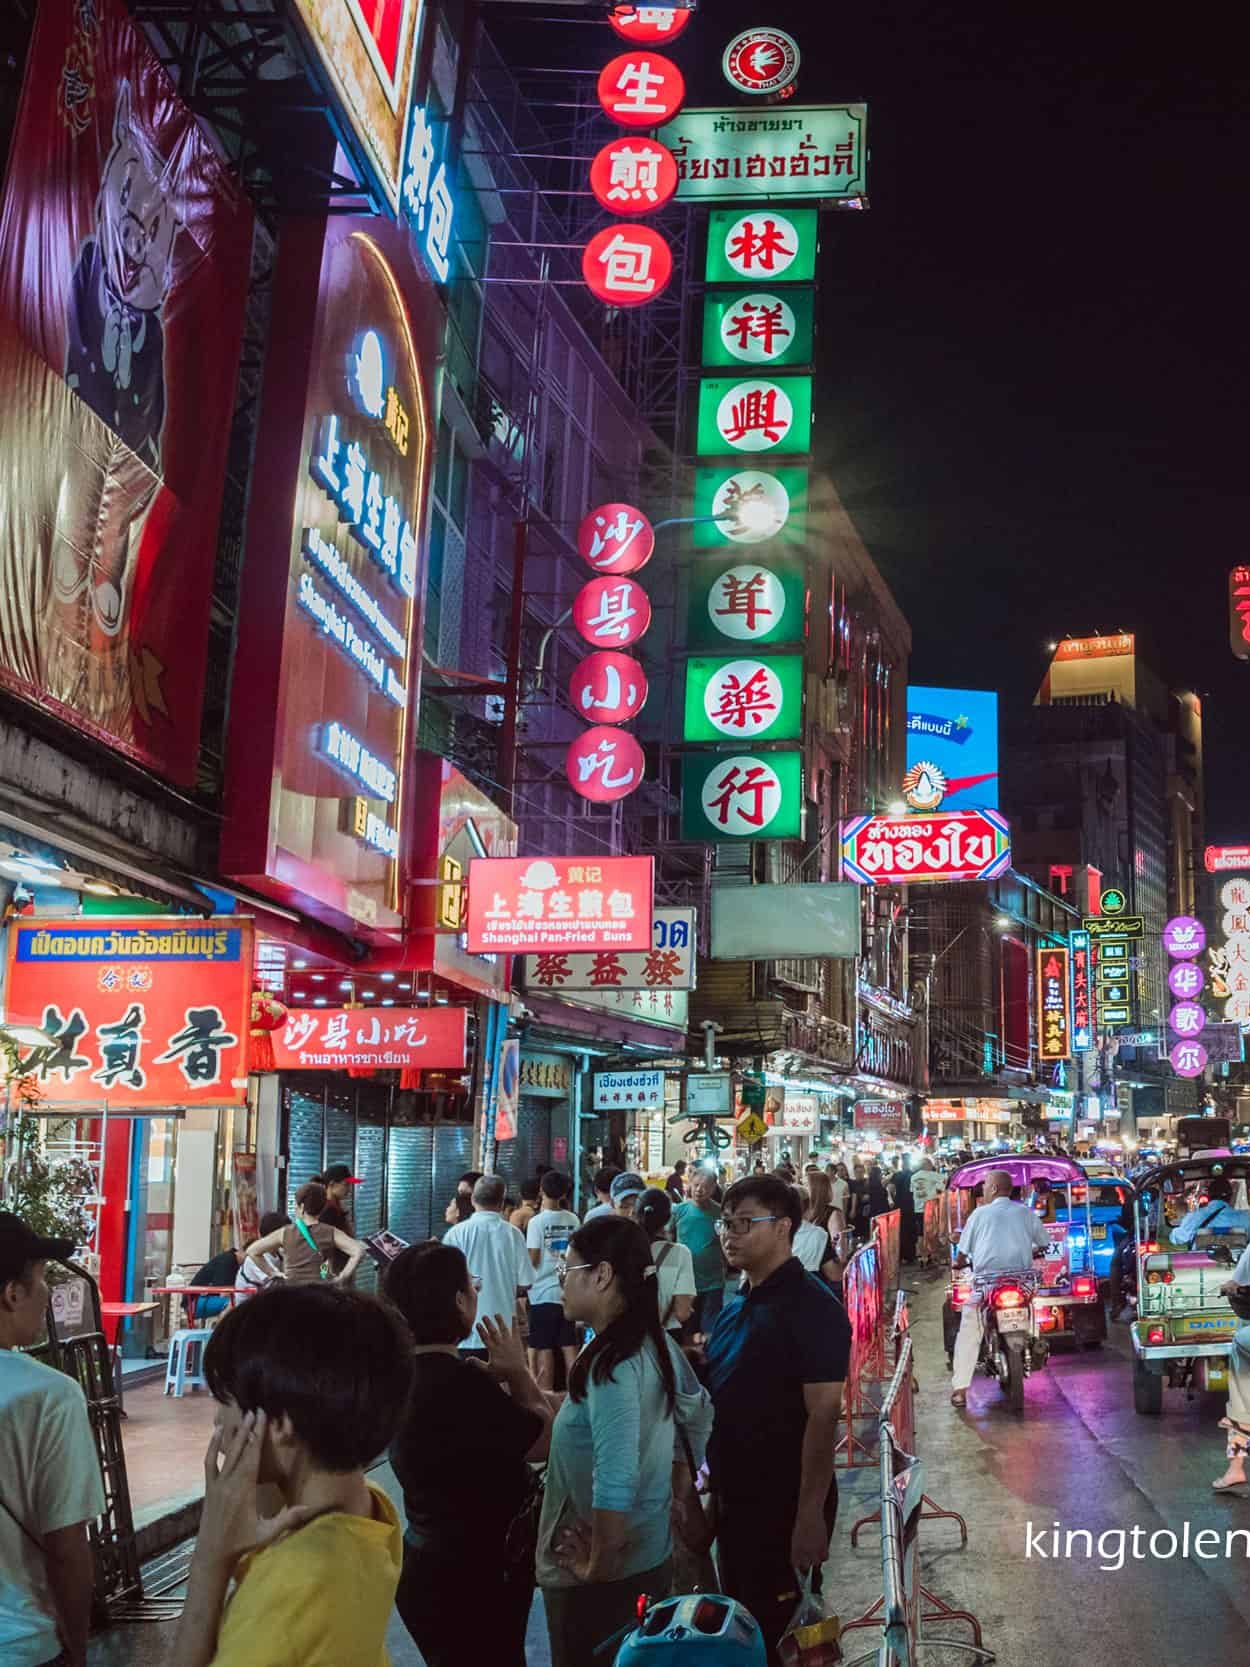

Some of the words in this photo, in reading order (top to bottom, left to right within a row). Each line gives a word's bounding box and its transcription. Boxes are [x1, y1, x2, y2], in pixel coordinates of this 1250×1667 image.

[713, 117, 803, 133] ห้างขายยา
[577, 511, 645, 788] 沙县小吃
[485, 890, 635, 919] 上海生煎包
[481, 933, 537, 945] Shanghai
[541, 932, 596, 943] Pan-Fried
[603, 931, 632, 942] Buns
[283, 1013, 427, 1049] 沙县小吃
[1174, 967, 1203, 1072] 华歌尔
